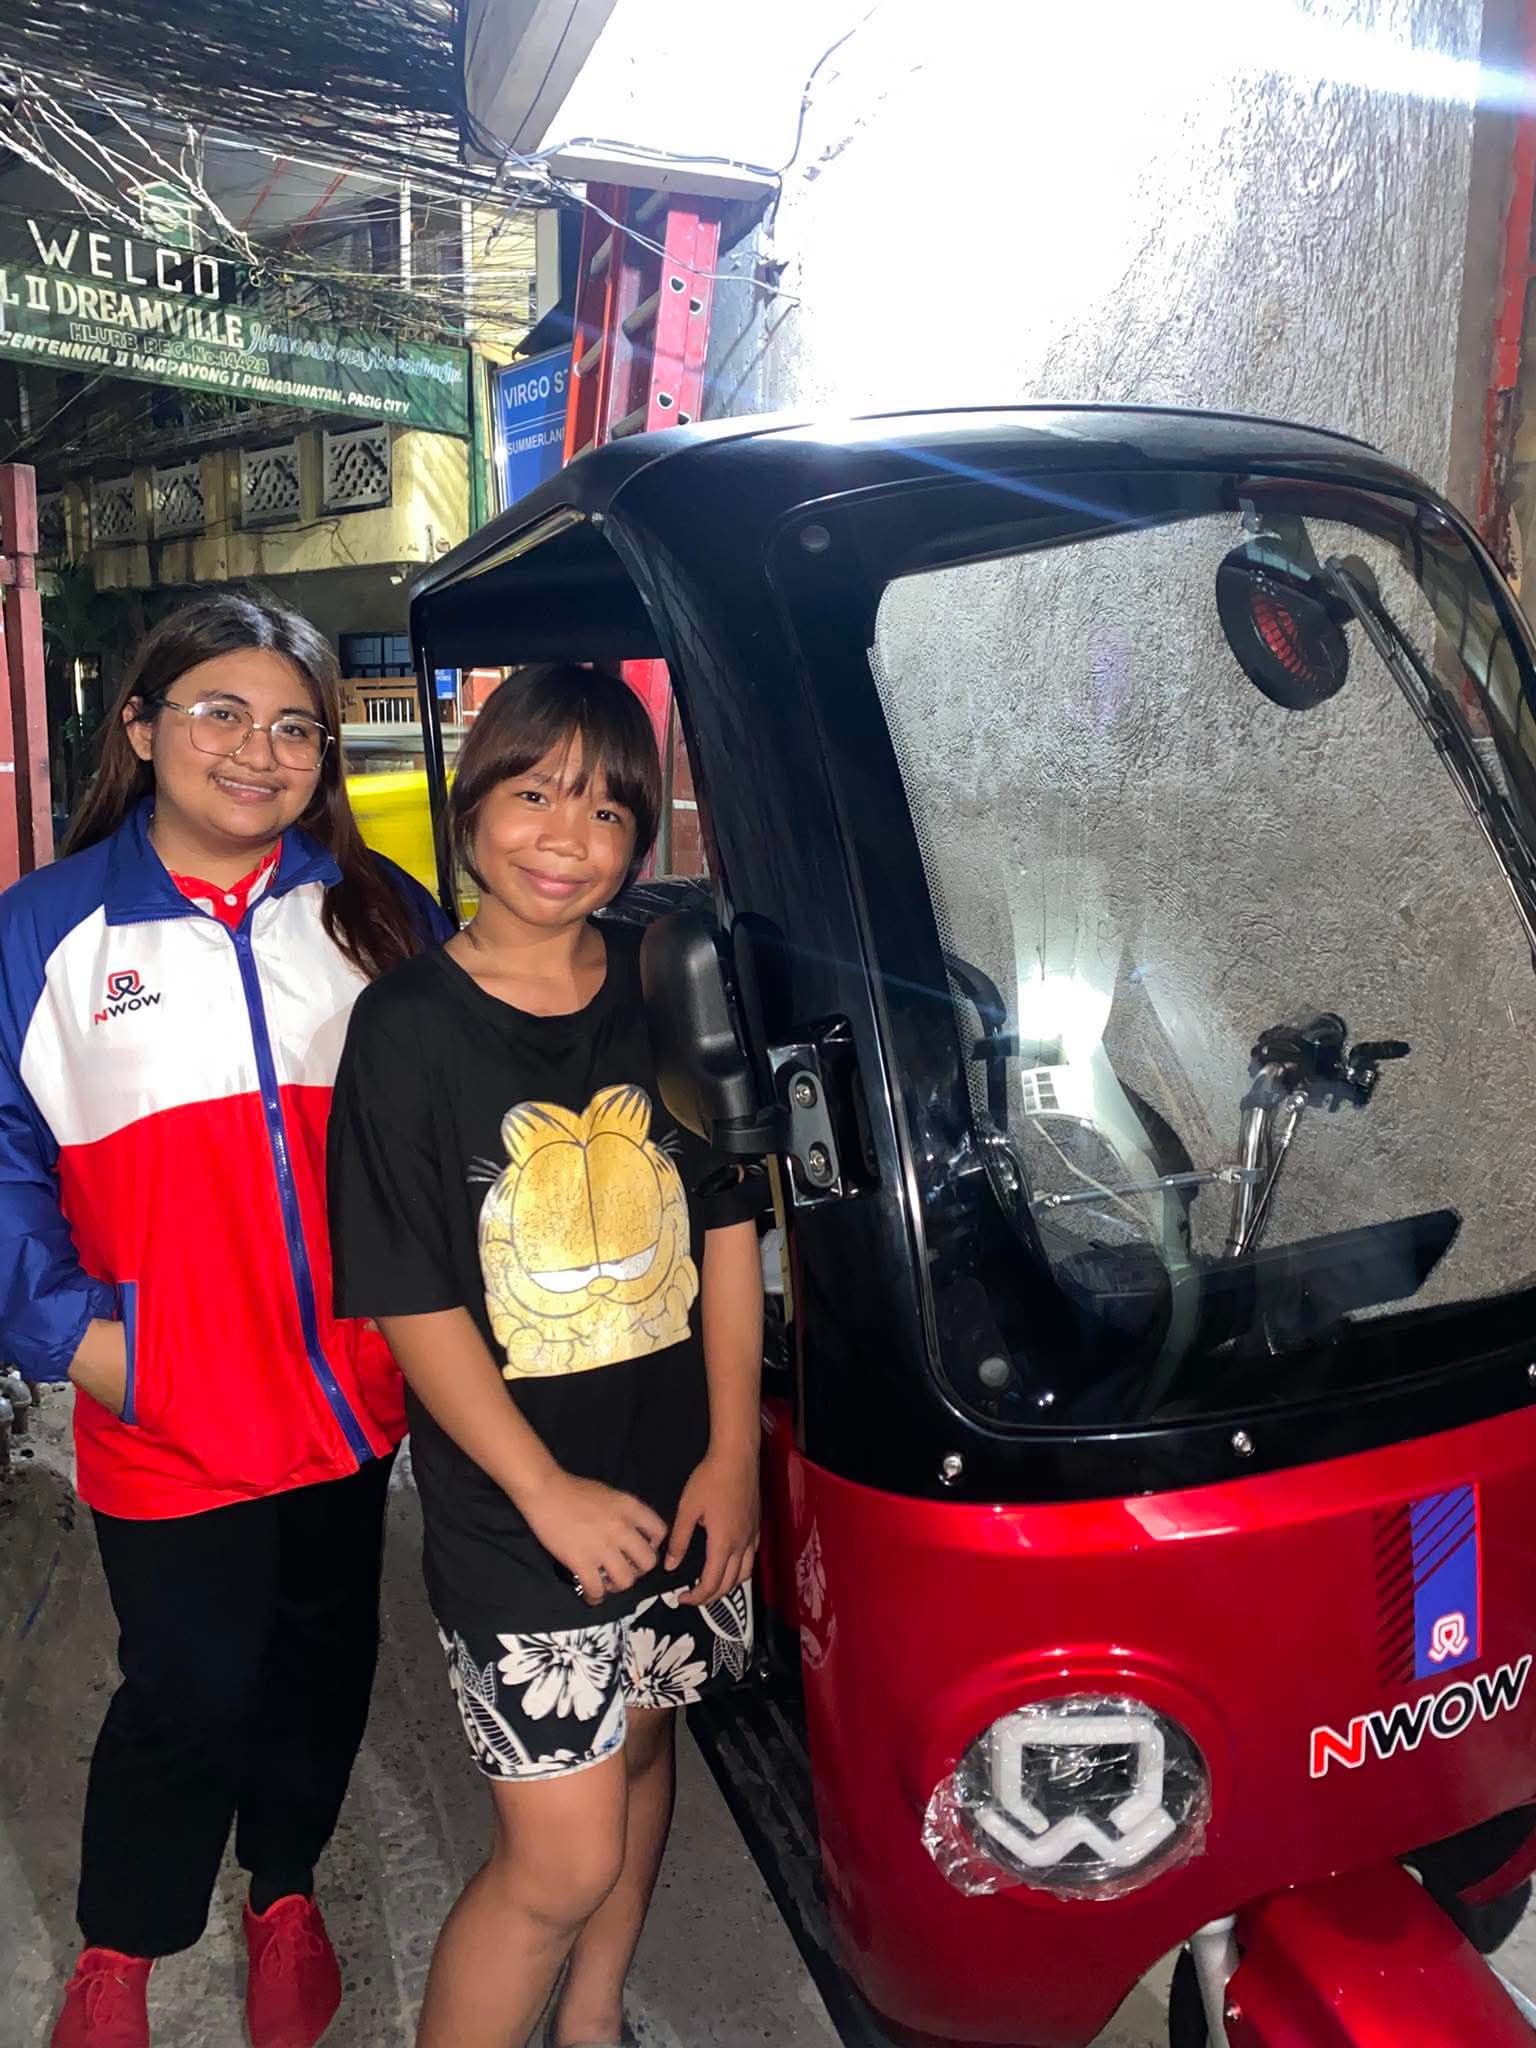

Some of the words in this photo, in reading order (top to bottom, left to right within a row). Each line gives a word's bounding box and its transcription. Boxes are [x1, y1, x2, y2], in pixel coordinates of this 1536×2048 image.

[27, 220, 220, 300] WELCO
[25, 274, 51, 312] II
[55, 279, 245, 349] DREAMVILLE
[69, 321, 138, 352] HLURB
[0, 330, 110, 365] CENTENNIAL
[113, 351, 129, 368] II
[132, 353, 230, 385] NAGPAYONG
[347, 391, 383, 411] PASIG
[383, 396, 411, 416] CITY
[504, 375, 550, 409] VIRGO
[553, 369, 568, 393] S
[507, 429, 566, 456] SUMMERLAN
[94, 992, 161, 1026] NWOW
[1309, 1654, 1532, 1779] NWOW
